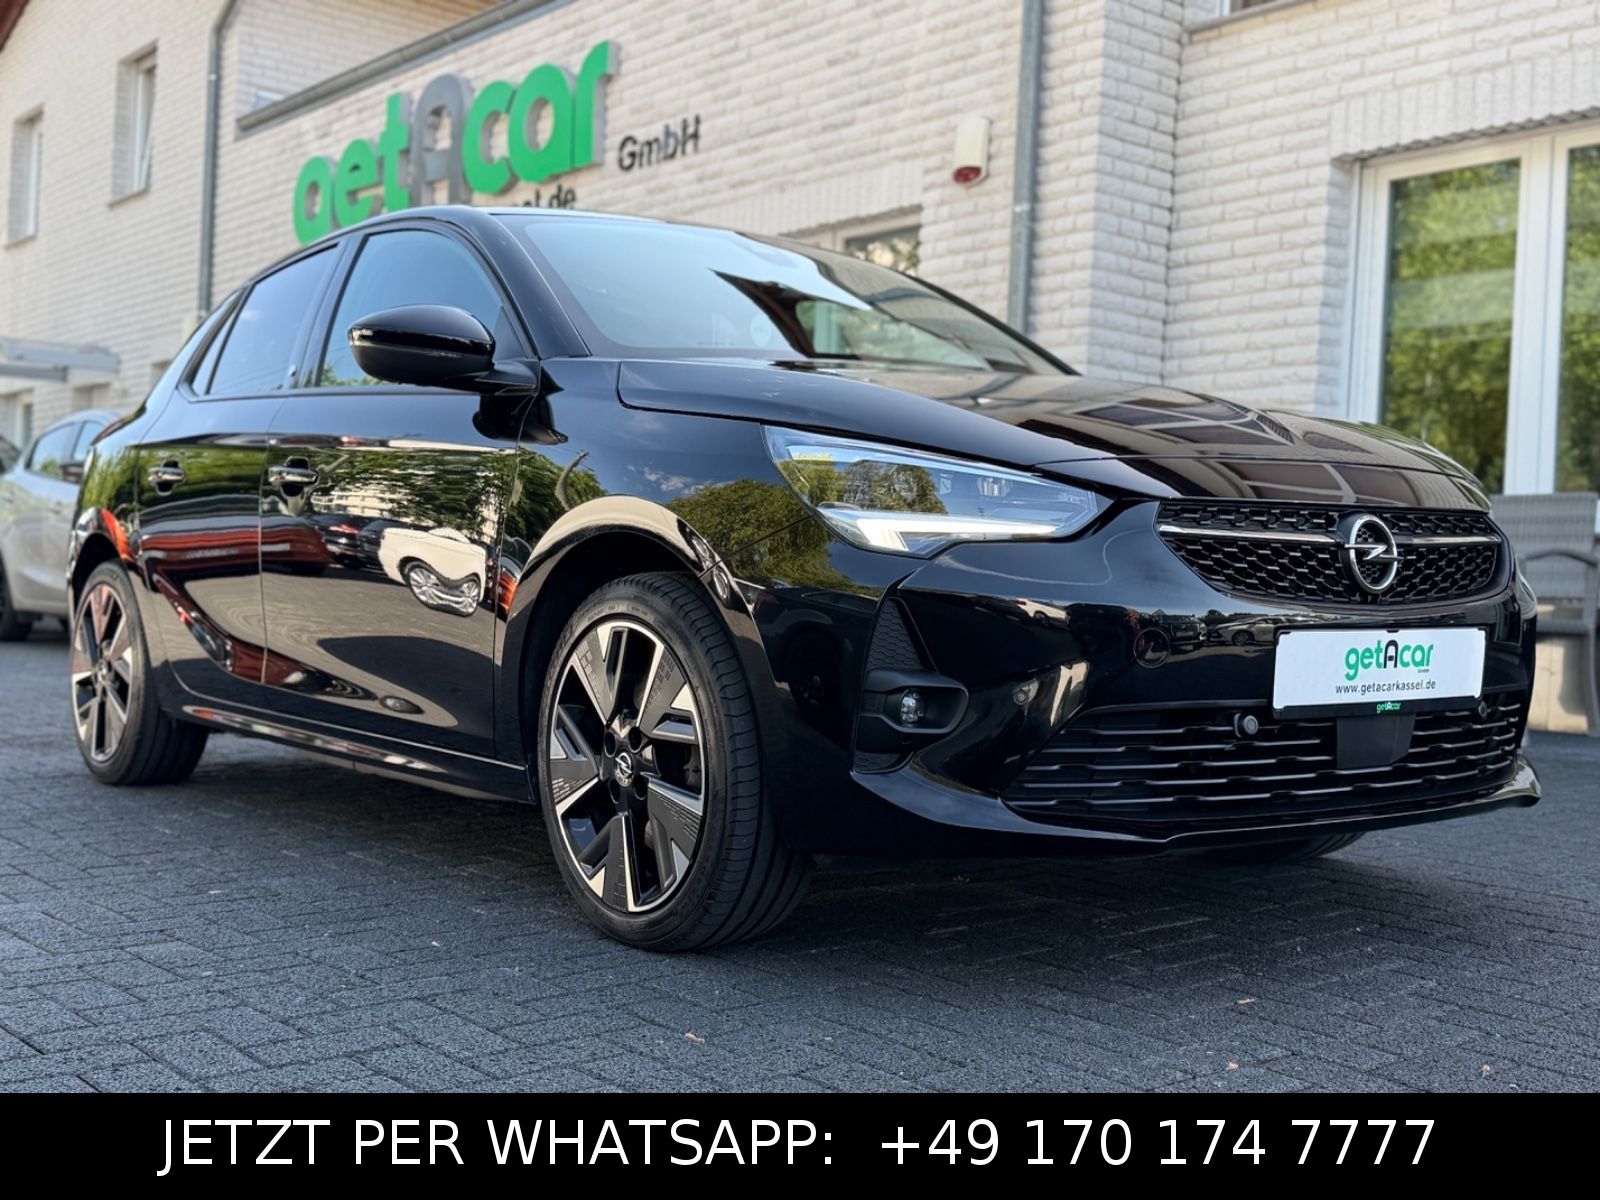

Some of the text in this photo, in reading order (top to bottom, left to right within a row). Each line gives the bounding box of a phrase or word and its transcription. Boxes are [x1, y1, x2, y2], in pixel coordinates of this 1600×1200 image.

[618, 114, 701, 172] GmbH
[1345, 639, 1433, 681] getAcar
[1335, 679, 1436, 696] www.getacarkassel.de
